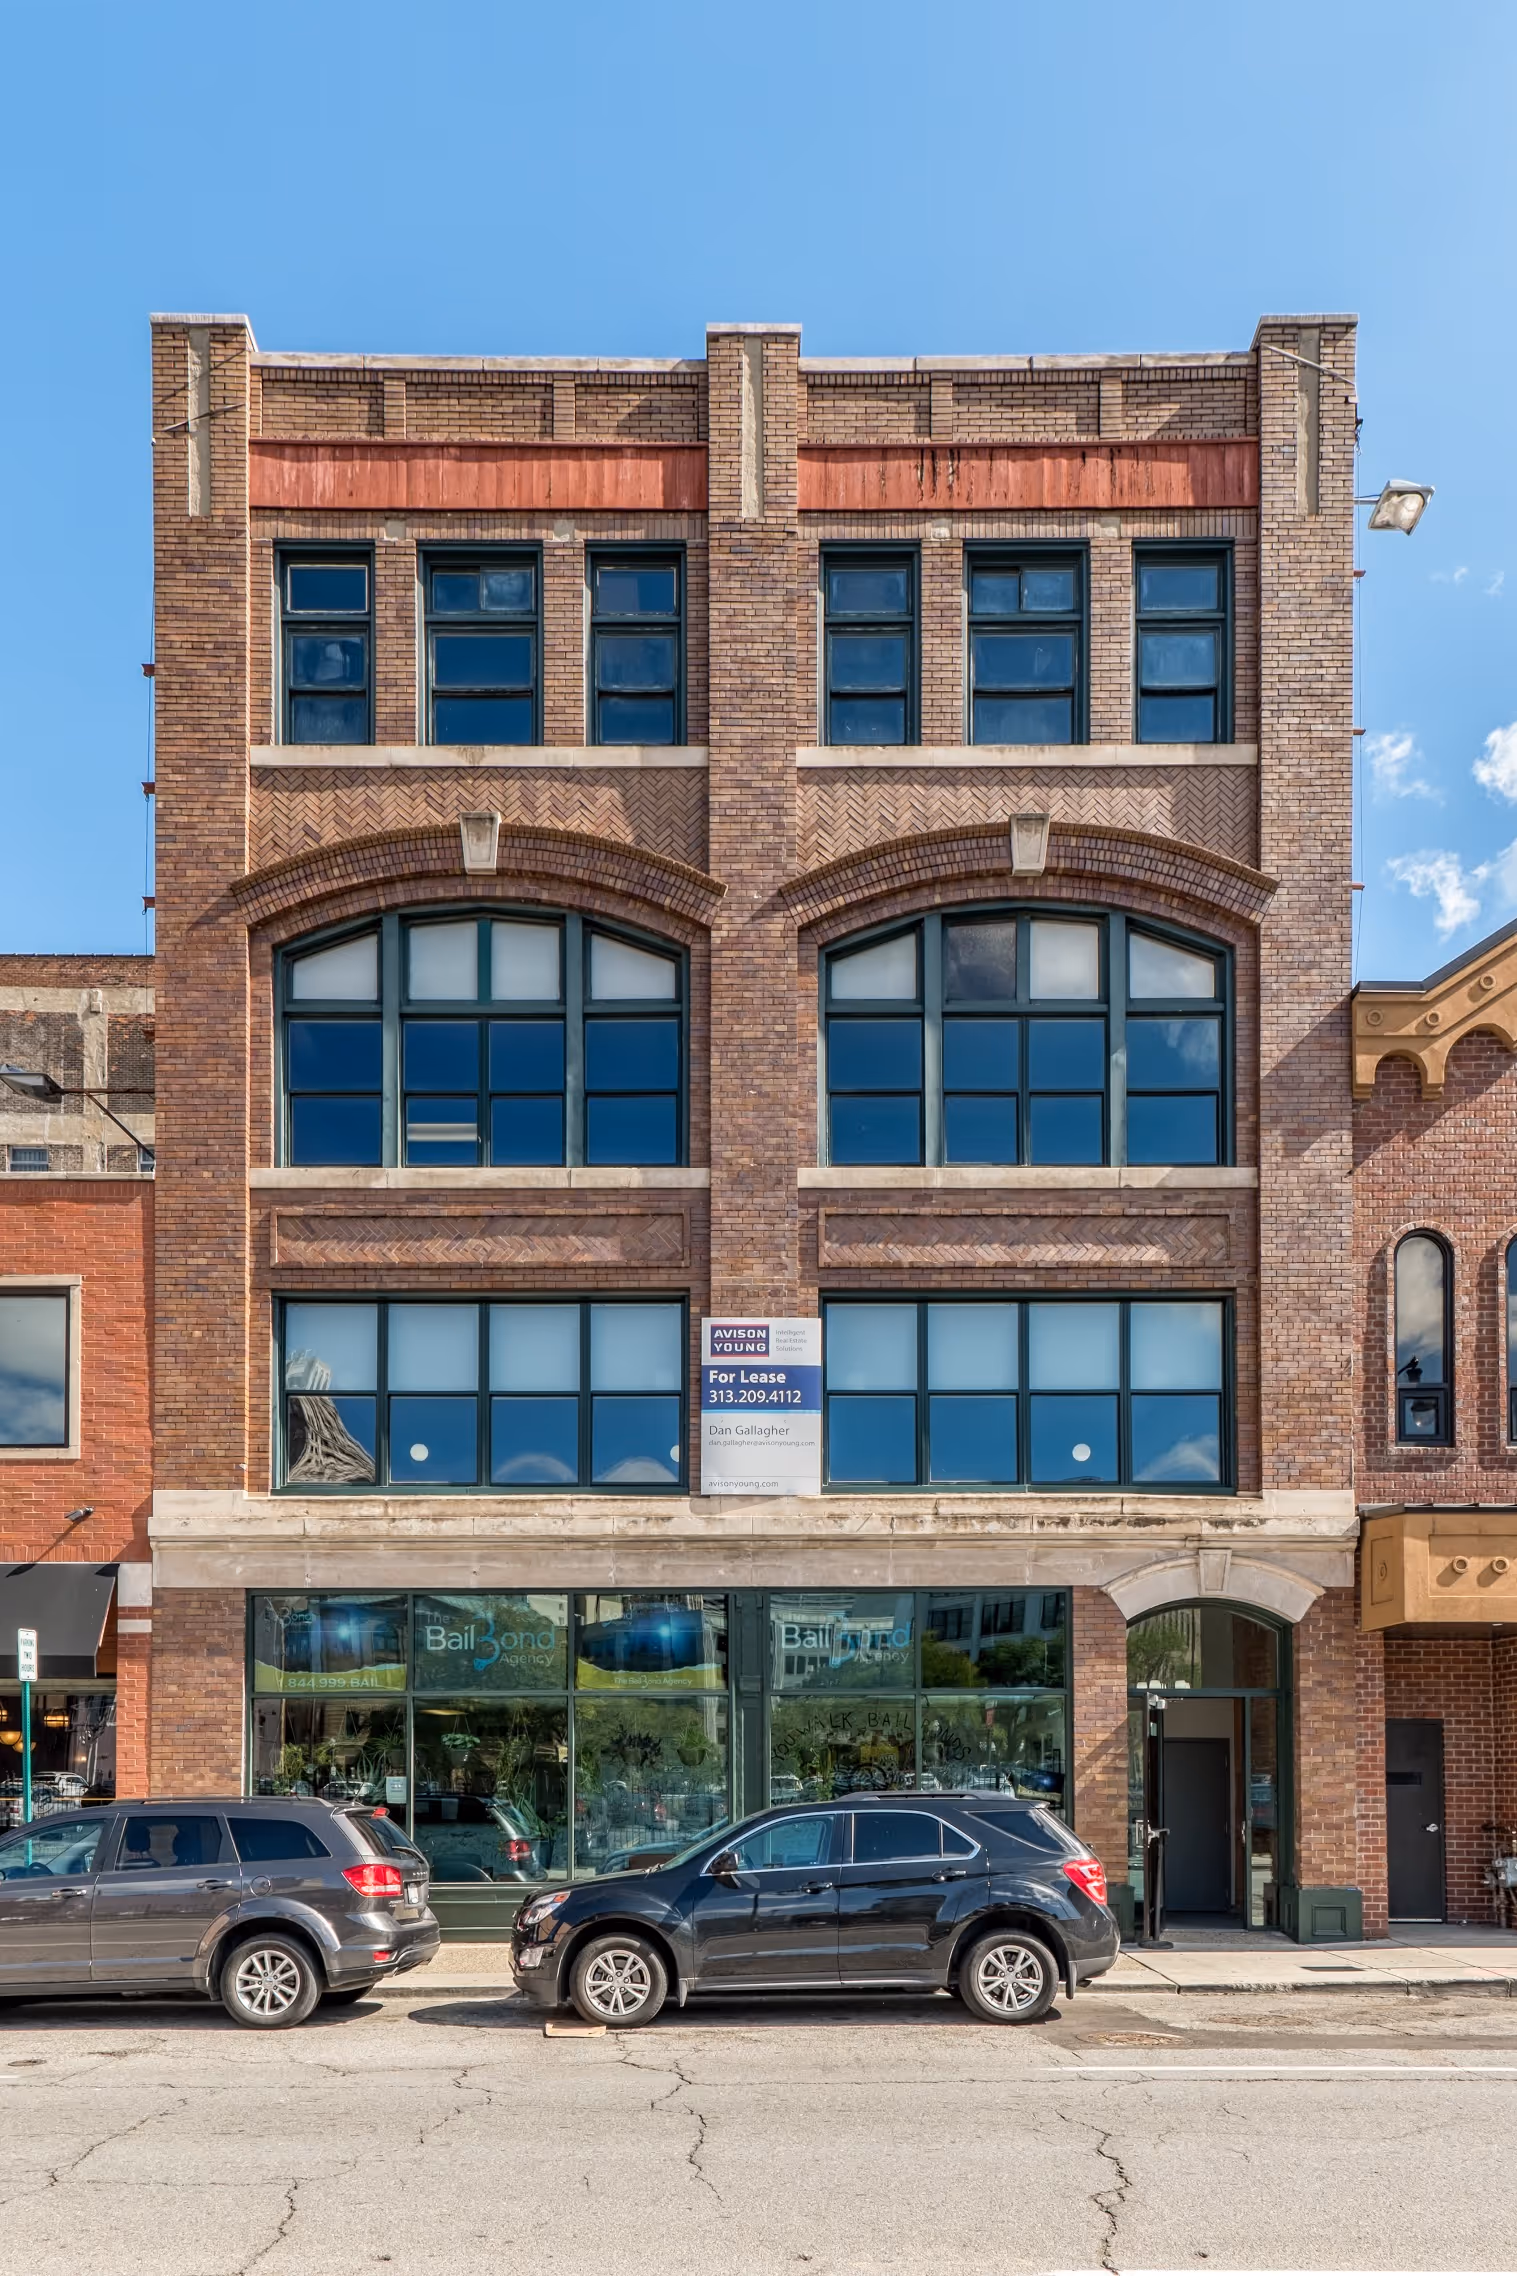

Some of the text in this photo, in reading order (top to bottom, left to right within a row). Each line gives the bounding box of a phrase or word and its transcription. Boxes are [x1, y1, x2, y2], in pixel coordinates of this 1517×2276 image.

[713, 1329, 767, 1339] AVISON
[713, 1343, 767, 1352] YOUNG
[709, 1370, 787, 1384] For Lease
[709, 1390, 802, 1403] 313.209.4112
[709, 1425, 790, 1438] Dan Gallagher
[708, 1439, 816, 1447] dan.gallagher@avisonyoung.com
[708, 1480, 779, 1489] avisonyoung.com
[499, 1653, 554, 1667] Agency
[663, 1676, 693, 1688] Agency
[771, 1734, 796, 1761] YOU
[800, 1711, 853, 1738] WALK
[868, 1712, 911, 1730] BAIL
